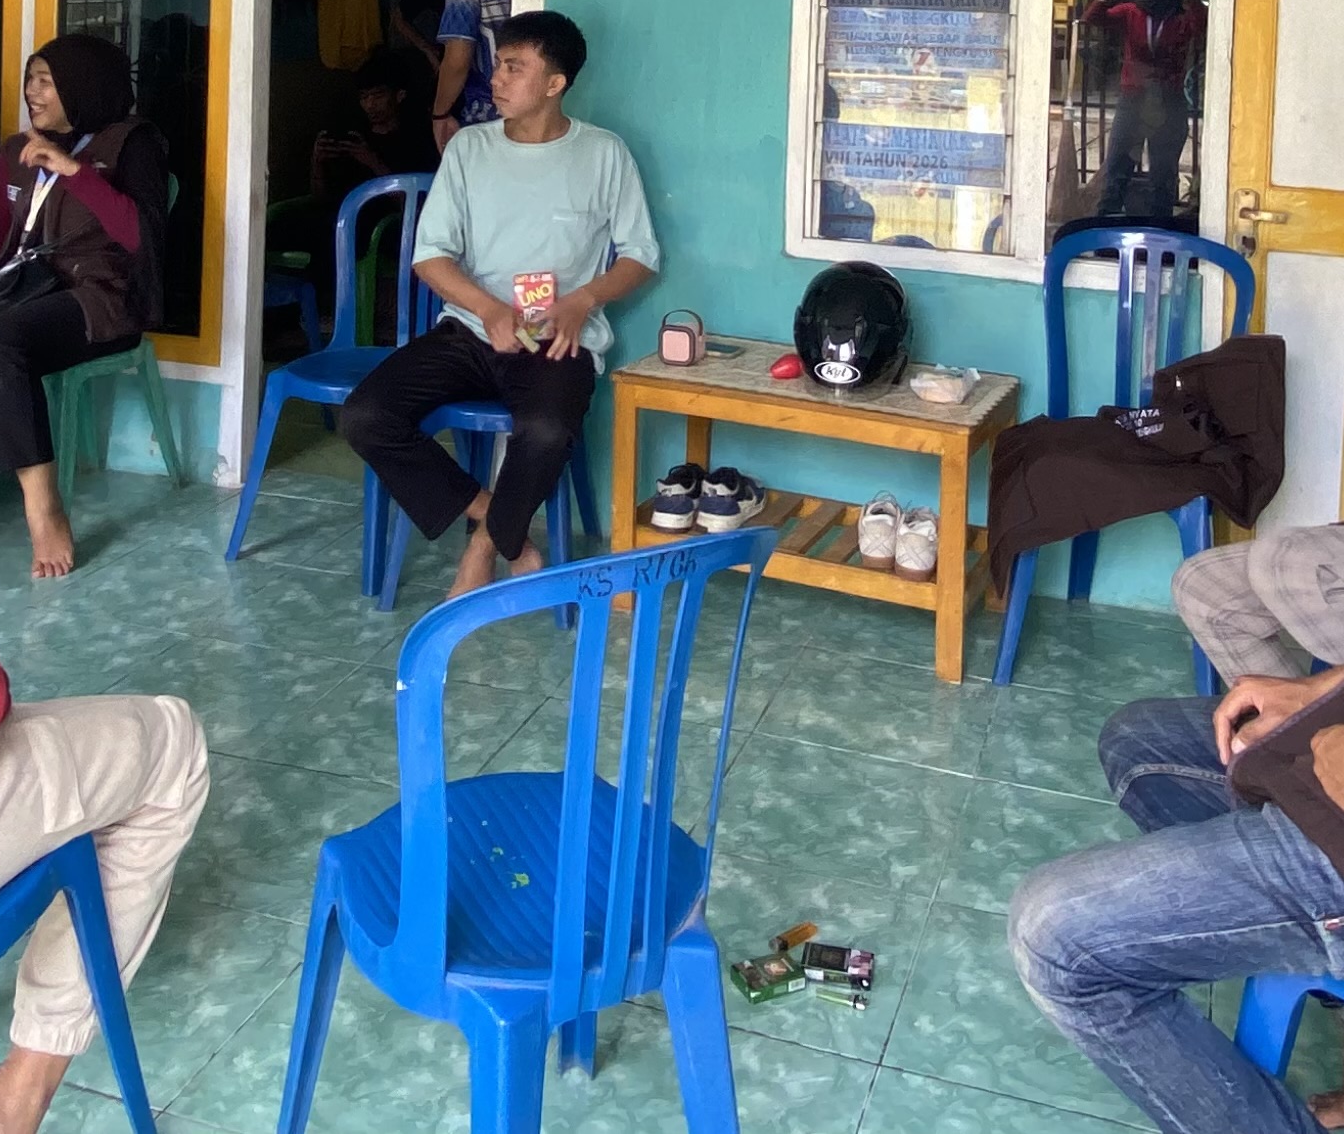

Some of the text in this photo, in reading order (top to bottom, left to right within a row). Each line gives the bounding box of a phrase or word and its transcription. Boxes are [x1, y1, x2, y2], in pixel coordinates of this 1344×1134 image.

[854, 152, 906, 168] TAHUN
[911, 155, 949, 170] 2026
[517, 282, 552, 307] UNO
